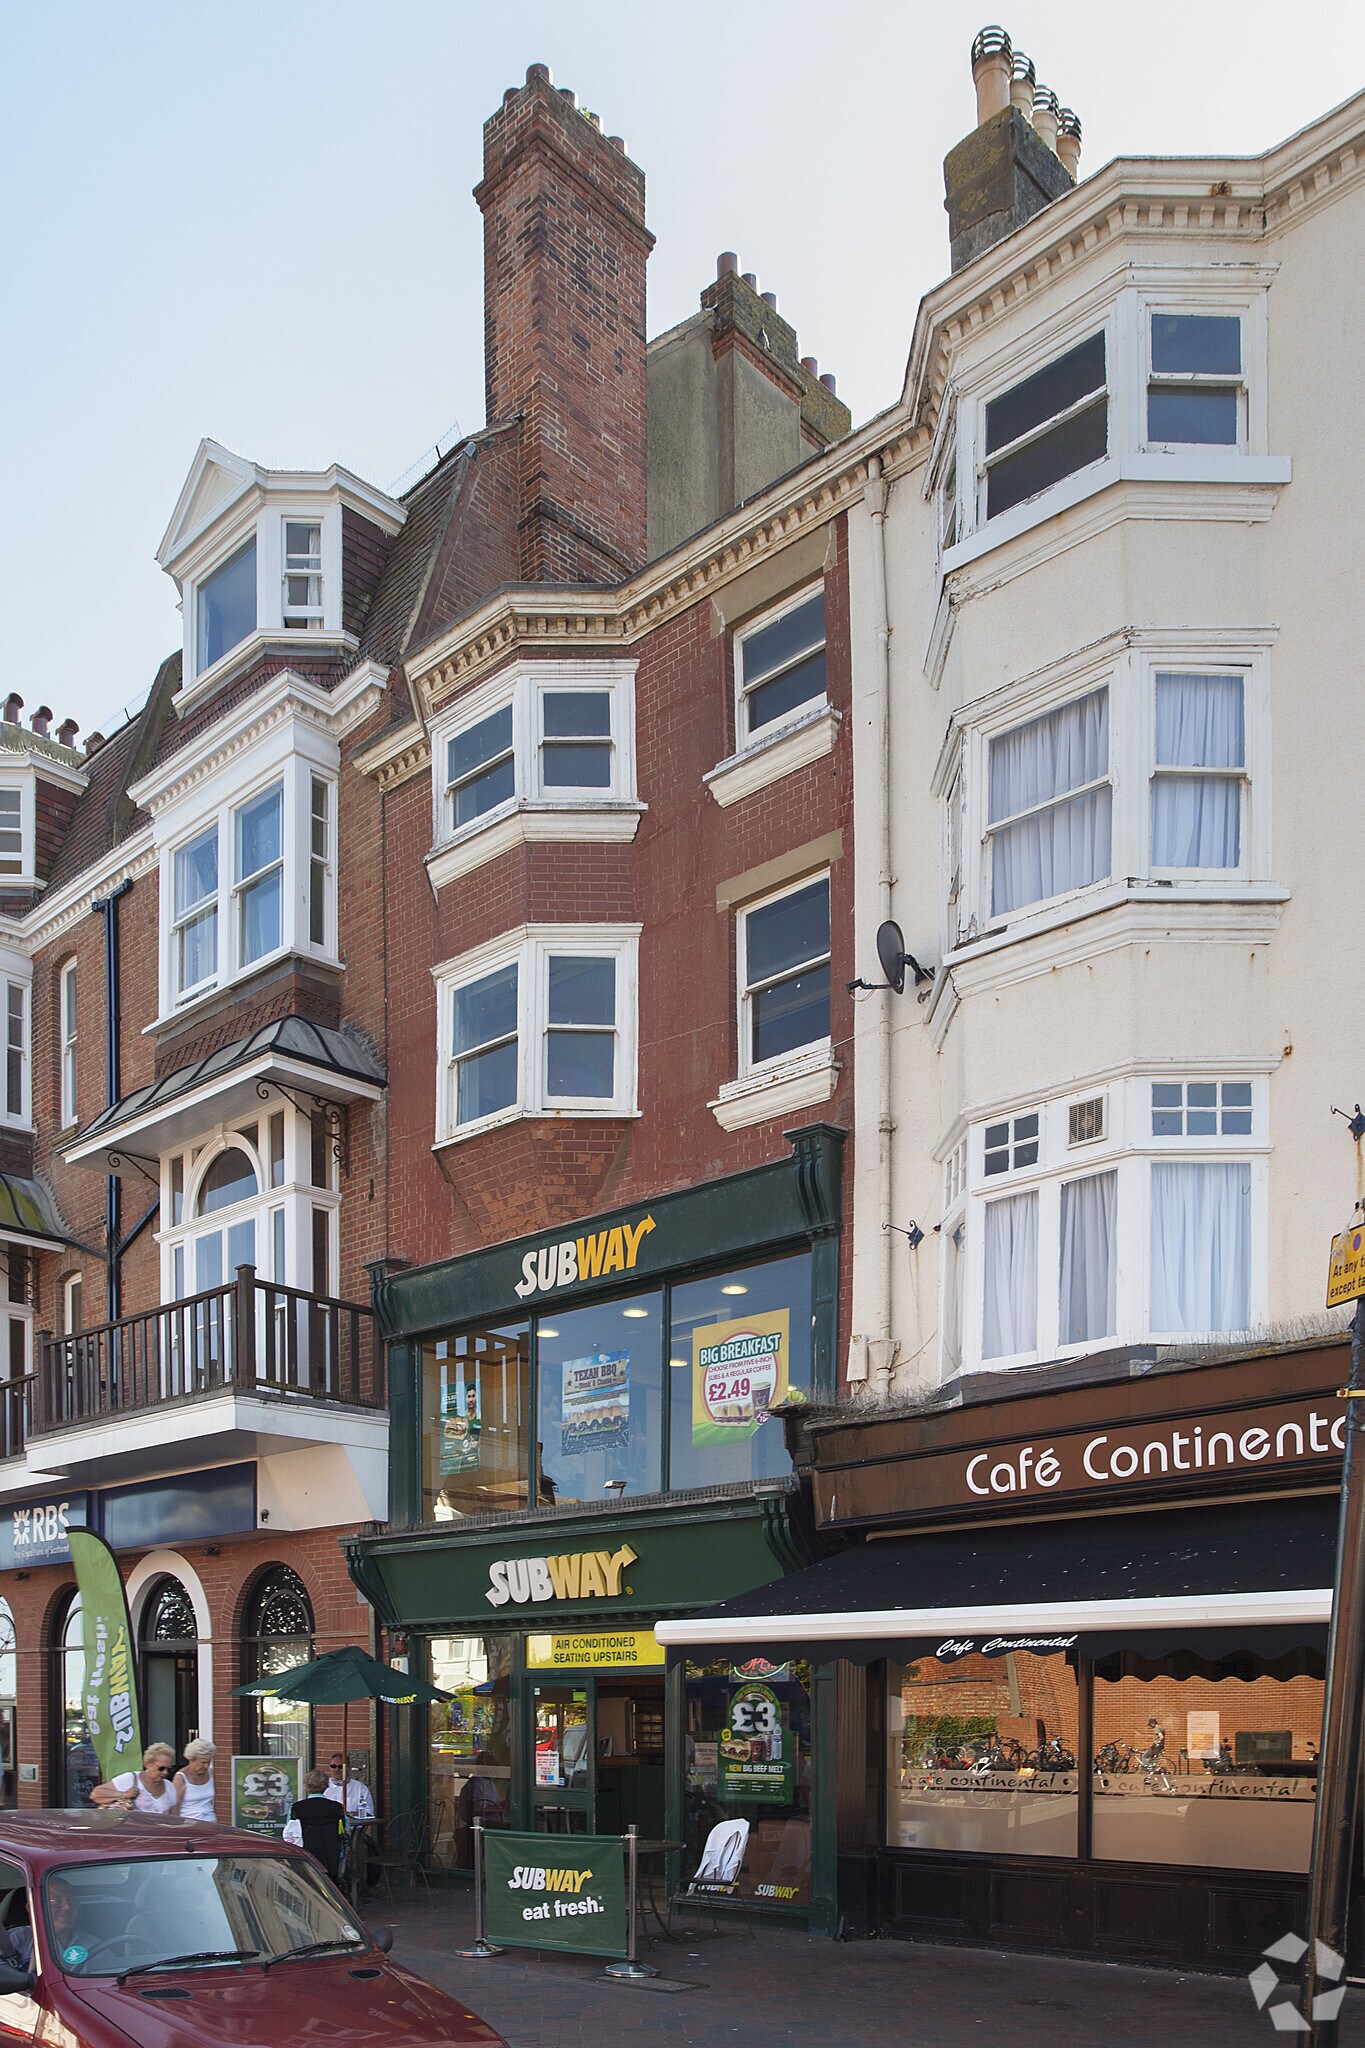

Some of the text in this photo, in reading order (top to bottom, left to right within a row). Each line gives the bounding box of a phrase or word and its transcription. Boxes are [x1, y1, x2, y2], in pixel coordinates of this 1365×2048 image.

[514, 1214, 656, 1299] SUBWAY
[1333, 1264, 1342, 1278] At
[1344, 1259, 1358, 1274] any
[1330, 1277, 1356, 1298] except
[700, 1333, 781, 1366] BIG BREAKFAST
[574, 1363, 617, 1382] TEXAN BBQ
[708, 1373, 720, 1381] SUBS
[730, 1367, 753, 1377] REGULAR
[753, 1364, 771, 1373] COFFEE
[709, 1365, 728, 1373] CHOOSE
[729, 1361, 743, 1369] FROM
[755, 1356, 771, 1364] 6-INCH
[708, 1377, 751, 1402] £2.49
[965, 1447, 1062, 1495] Café
[33, 1502, 70, 1543] RBS
[485, 1544, 638, 1608] SUBWAY
[555, 1636, 636, 1650] AIR CONDITIONED
[935, 1634, 1078, 1657] Cafe Continental
[553, 1651, 638, 1663] SEATING UPSTAIRS
[732, 1702, 776, 1732] £3
[743, 1765, 753, 1773] BIG
[753, 1765, 768, 1773] BEEF
[768, 1765, 784, 1774] MELT
[243, 1773, 290, 1797] £3
[951, 1773, 1055, 1789] continental
[507, 1866, 593, 1893] SUBWAY
[754, 1883, 799, 1899] SUBWAY
[522, 1902, 550, 1921] eat
